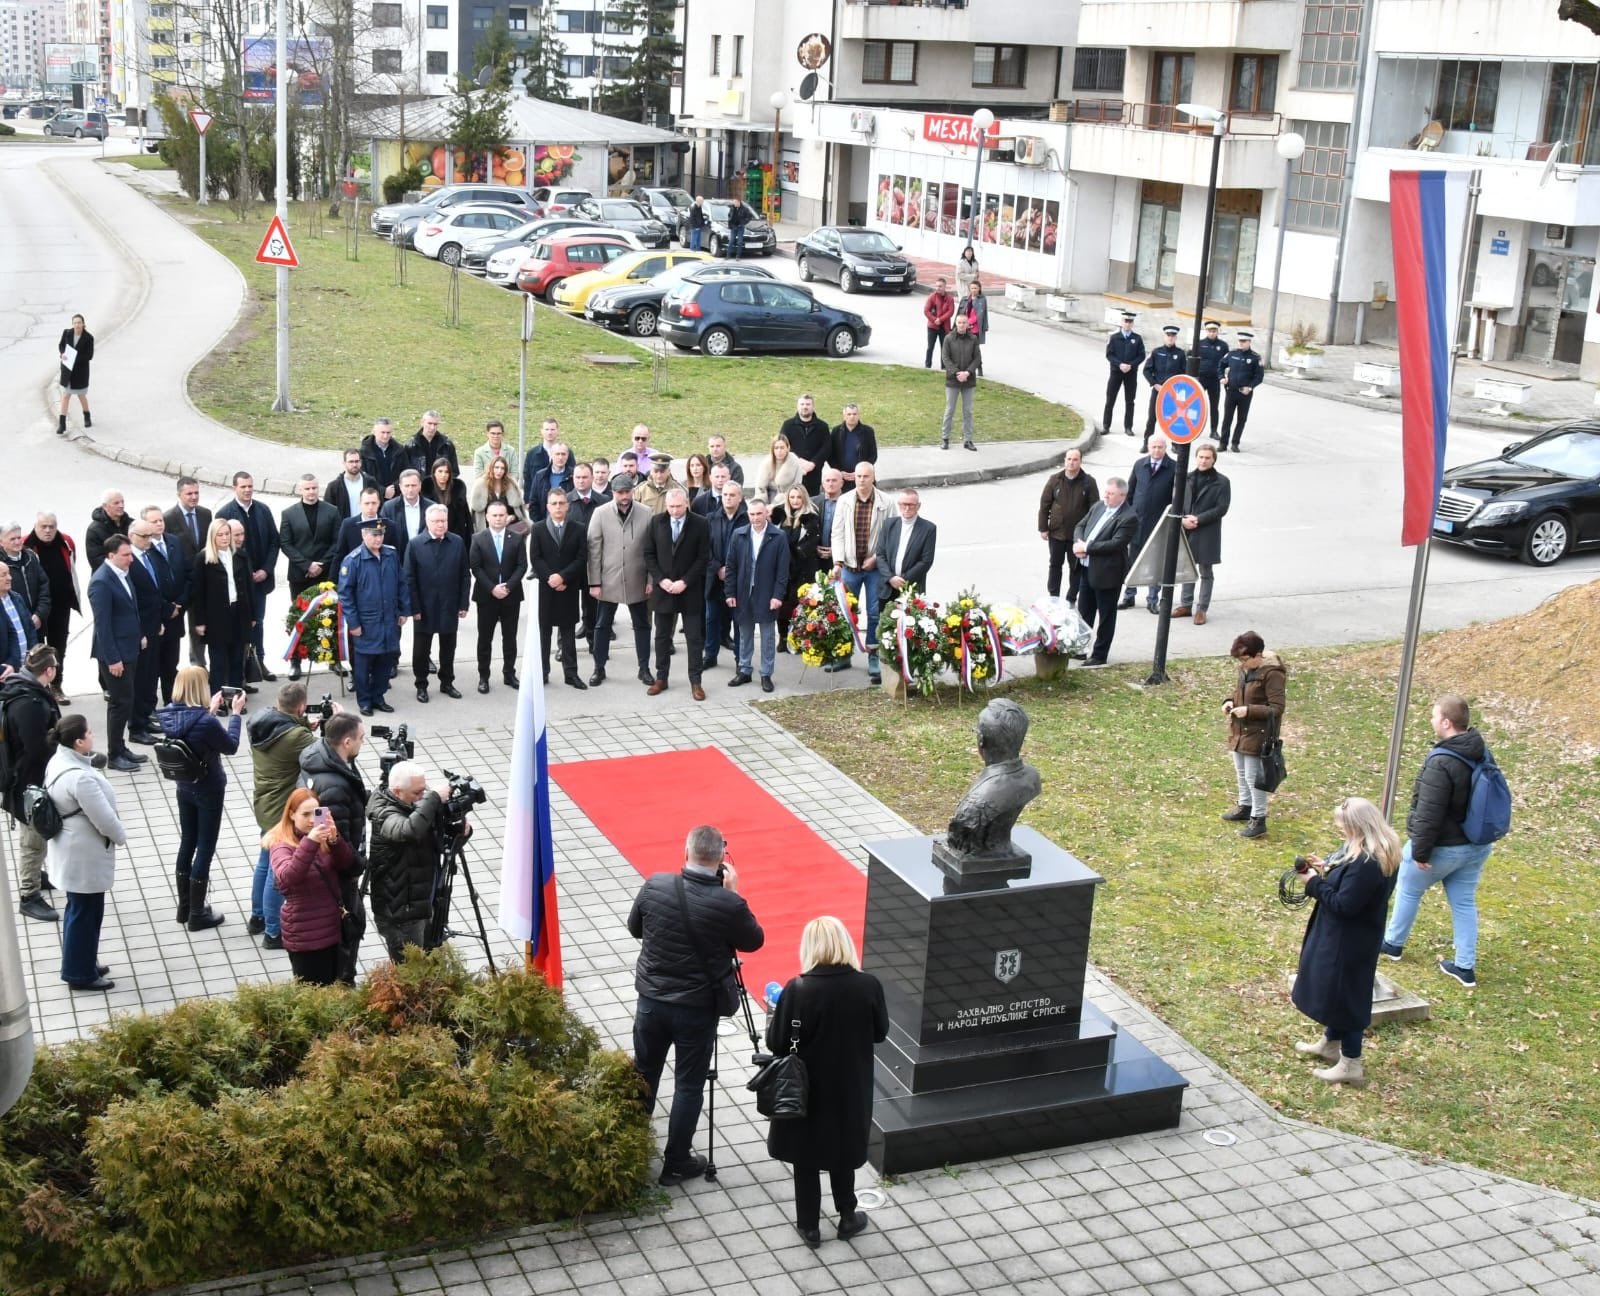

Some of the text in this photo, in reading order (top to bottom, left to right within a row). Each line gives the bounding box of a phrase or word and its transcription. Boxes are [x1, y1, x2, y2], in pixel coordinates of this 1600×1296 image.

[928, 117, 989, 144] MESAR
[937, 1004, 1067, 1032] И НАРОД РЕПУБЛИКЕ СРПСКЕ
[957, 997, 1051, 1019] ЗАХВАЛНО СРПСТВО
